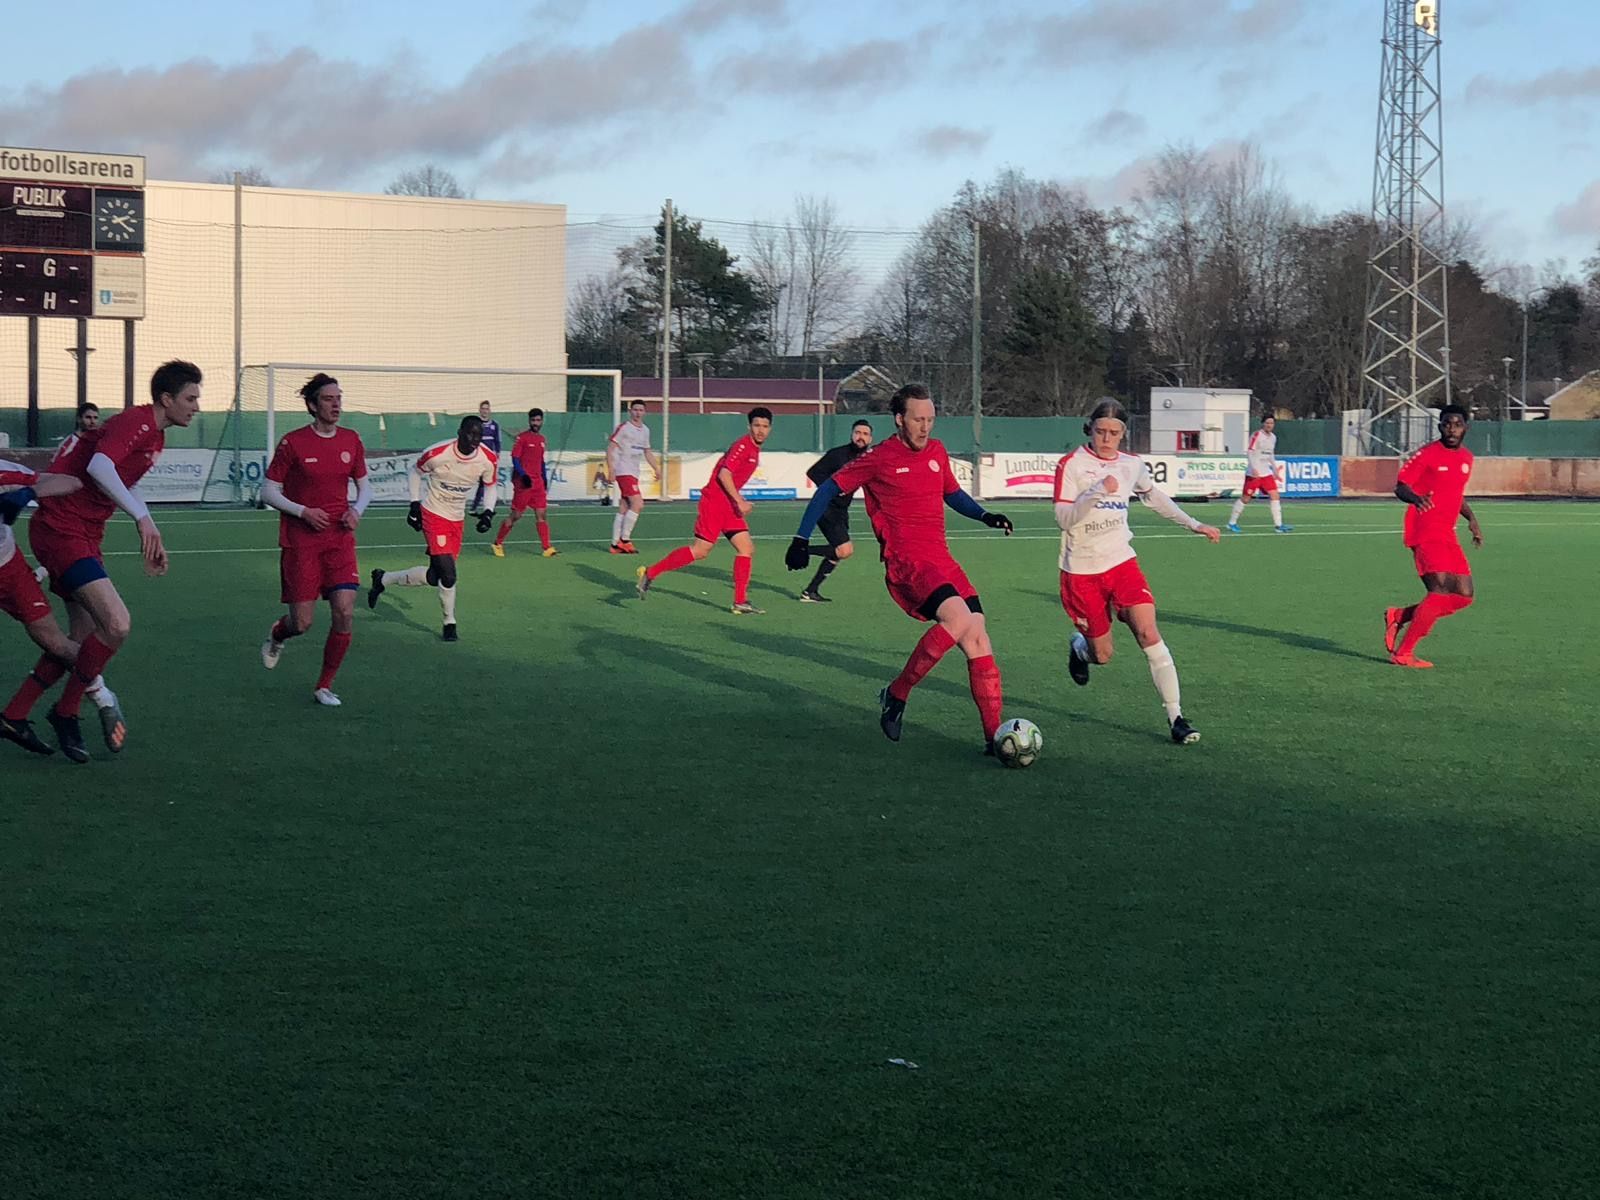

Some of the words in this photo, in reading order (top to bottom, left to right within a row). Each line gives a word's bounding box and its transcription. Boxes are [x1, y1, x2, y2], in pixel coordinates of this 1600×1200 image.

[0, 151, 134, 178] fotbollsarena
[13, 186, 67, 207] PUBLIK
[43, 258, 57, 277] G
[43, 291, 57, 310] H
[1187, 462, 1216, 472] RYDS
[1287, 461, 1332, 480] WEDA
